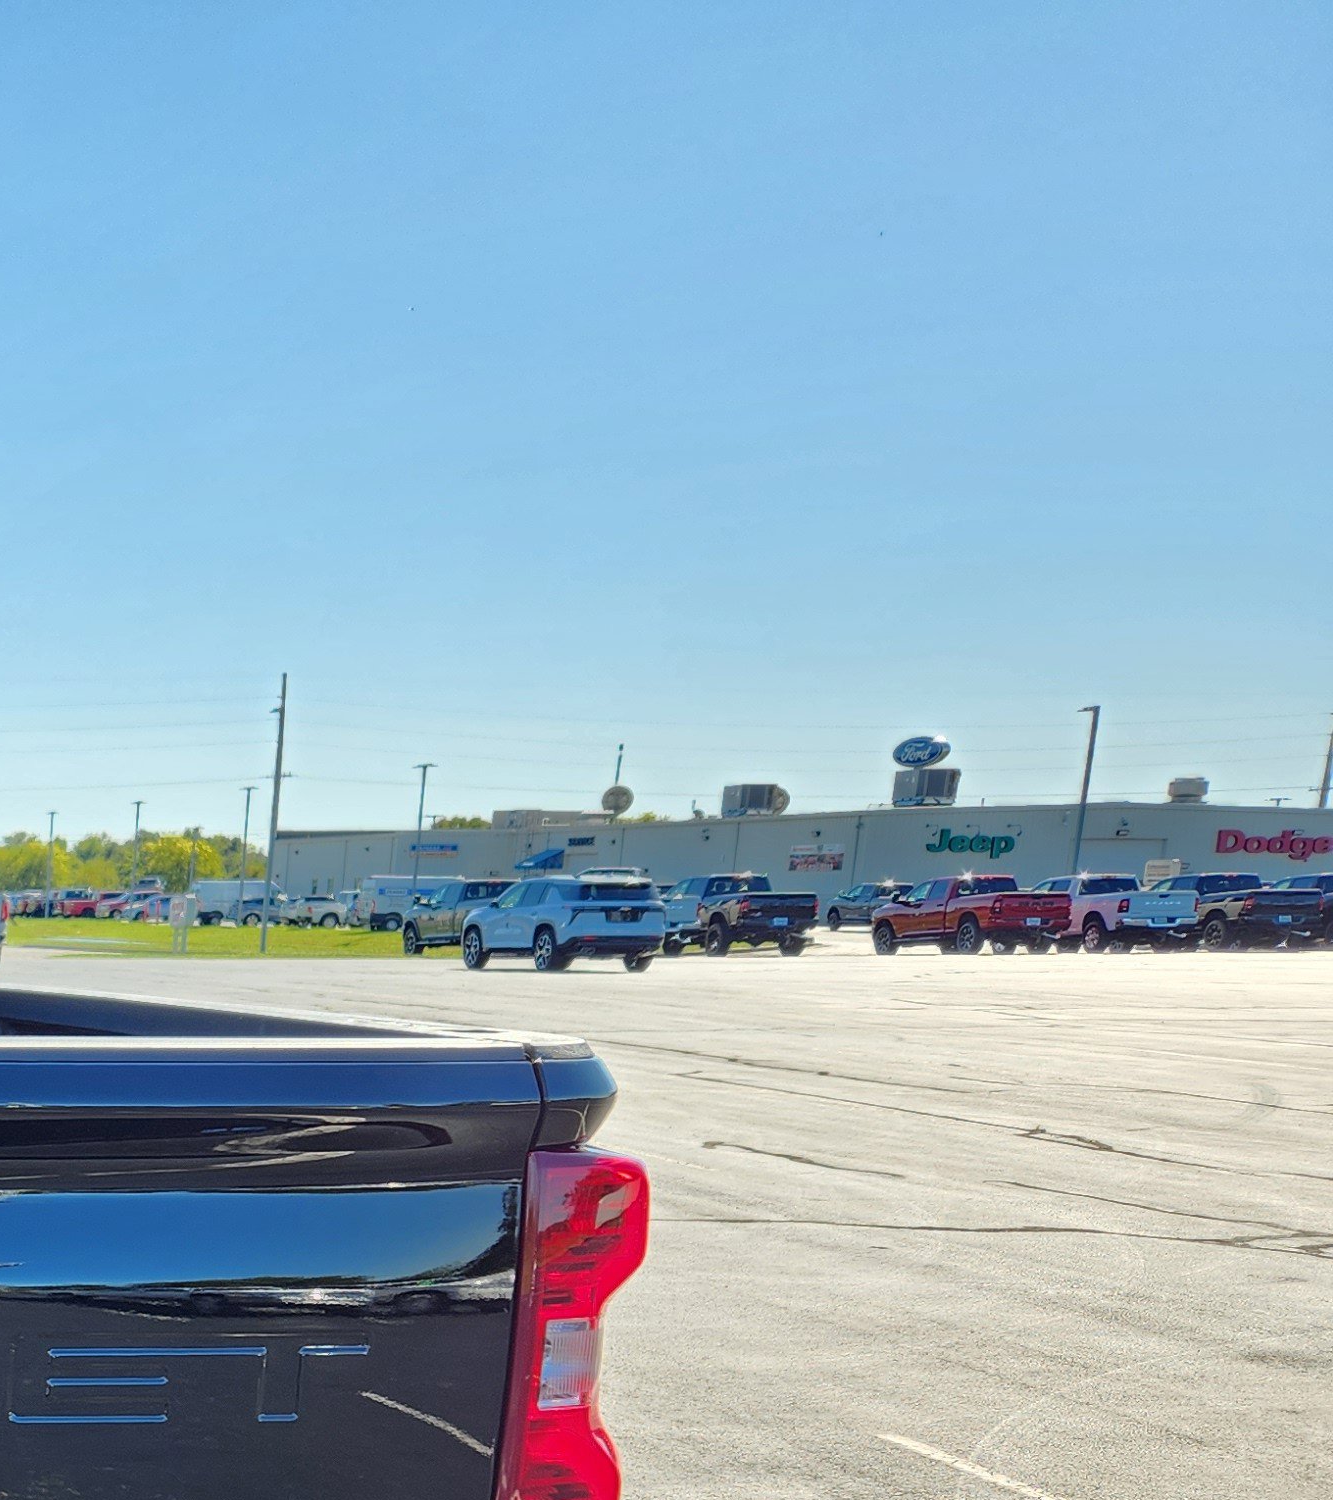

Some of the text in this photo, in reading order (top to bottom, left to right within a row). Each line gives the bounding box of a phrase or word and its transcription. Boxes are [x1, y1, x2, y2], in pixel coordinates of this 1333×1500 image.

[900, 741, 933, 762] Ford
[925, 828, 1016, 860] Jeep
[1215, 829, 1333, 860] Dodge
